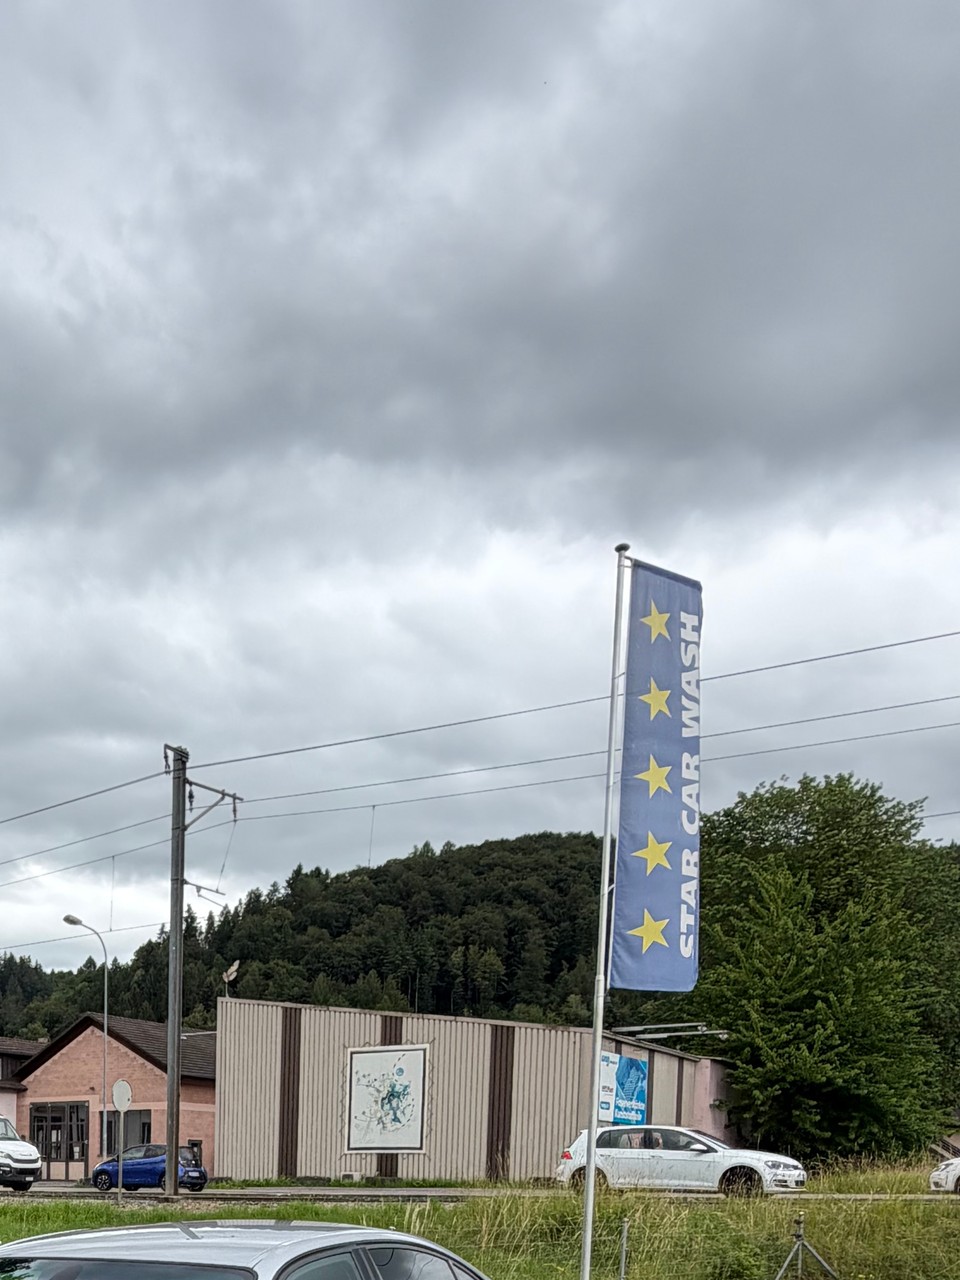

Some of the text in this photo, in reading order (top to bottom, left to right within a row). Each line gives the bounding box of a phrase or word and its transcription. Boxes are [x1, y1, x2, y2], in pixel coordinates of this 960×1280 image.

[680, 611, 700, 958] STAR CAR WASH
